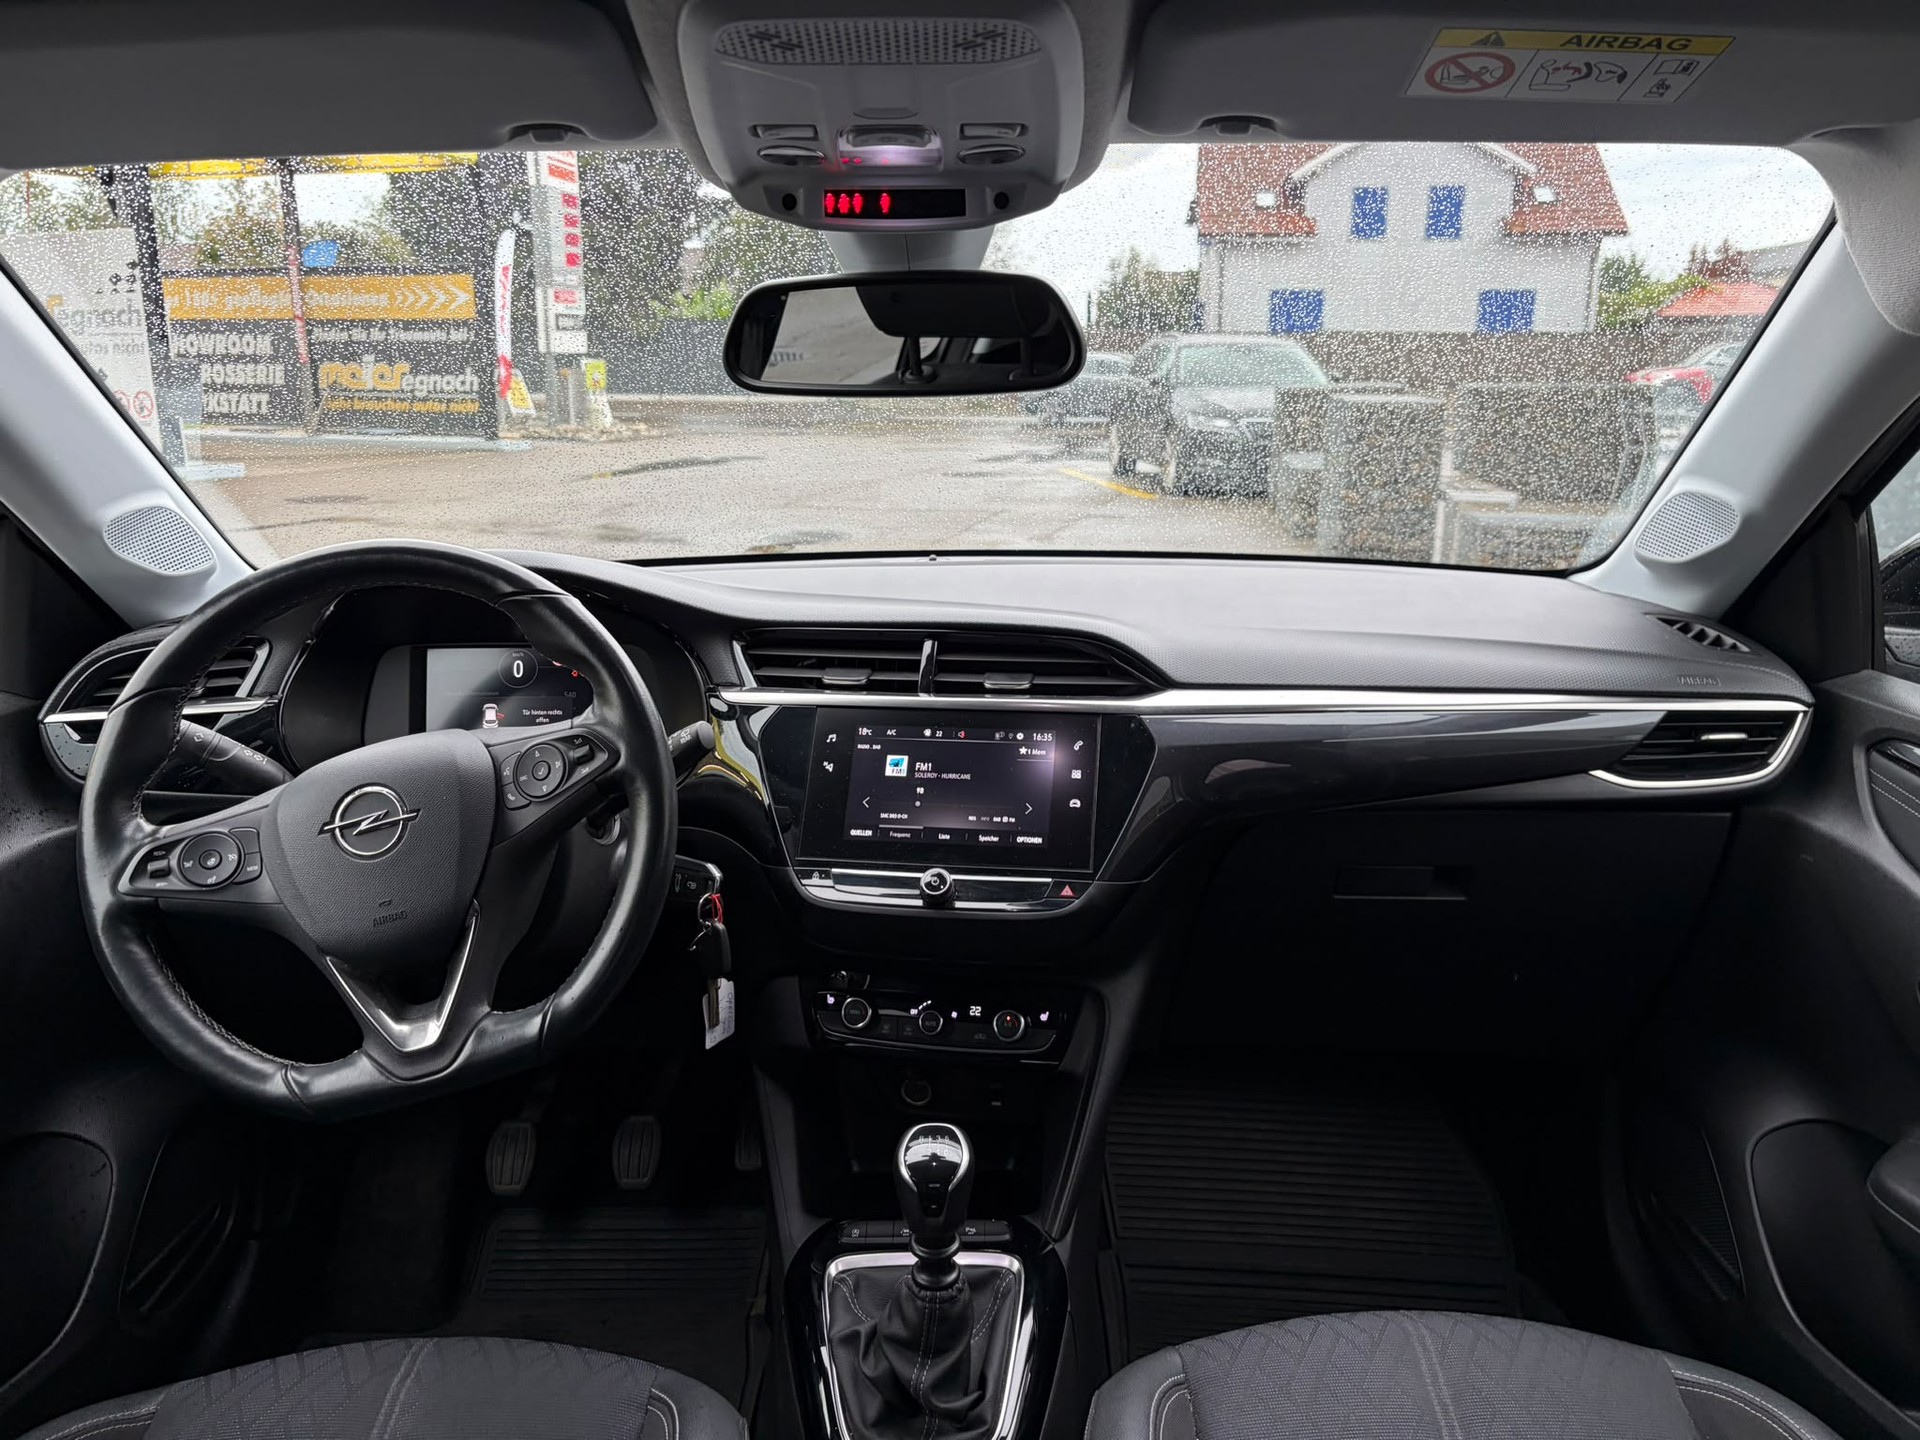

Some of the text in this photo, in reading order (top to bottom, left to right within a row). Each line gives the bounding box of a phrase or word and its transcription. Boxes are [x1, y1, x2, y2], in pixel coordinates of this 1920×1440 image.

[1559, 34, 1693, 52] AIRBAG
[200, 362, 285, 385] ROSSERIE
[402, 366, 480, 398] egnach
[513, 660, 524, 678] 0
[1033, 733, 1053, 741] 16:35
[915, 762, 932, 771] FM1
[978, 834, 999, 842] Speicher
[1016, 836, 1043, 844] OPTIONEN
[373, 910, 408, 927] AIRBAG
[969, 1006, 982, 1017] 22
